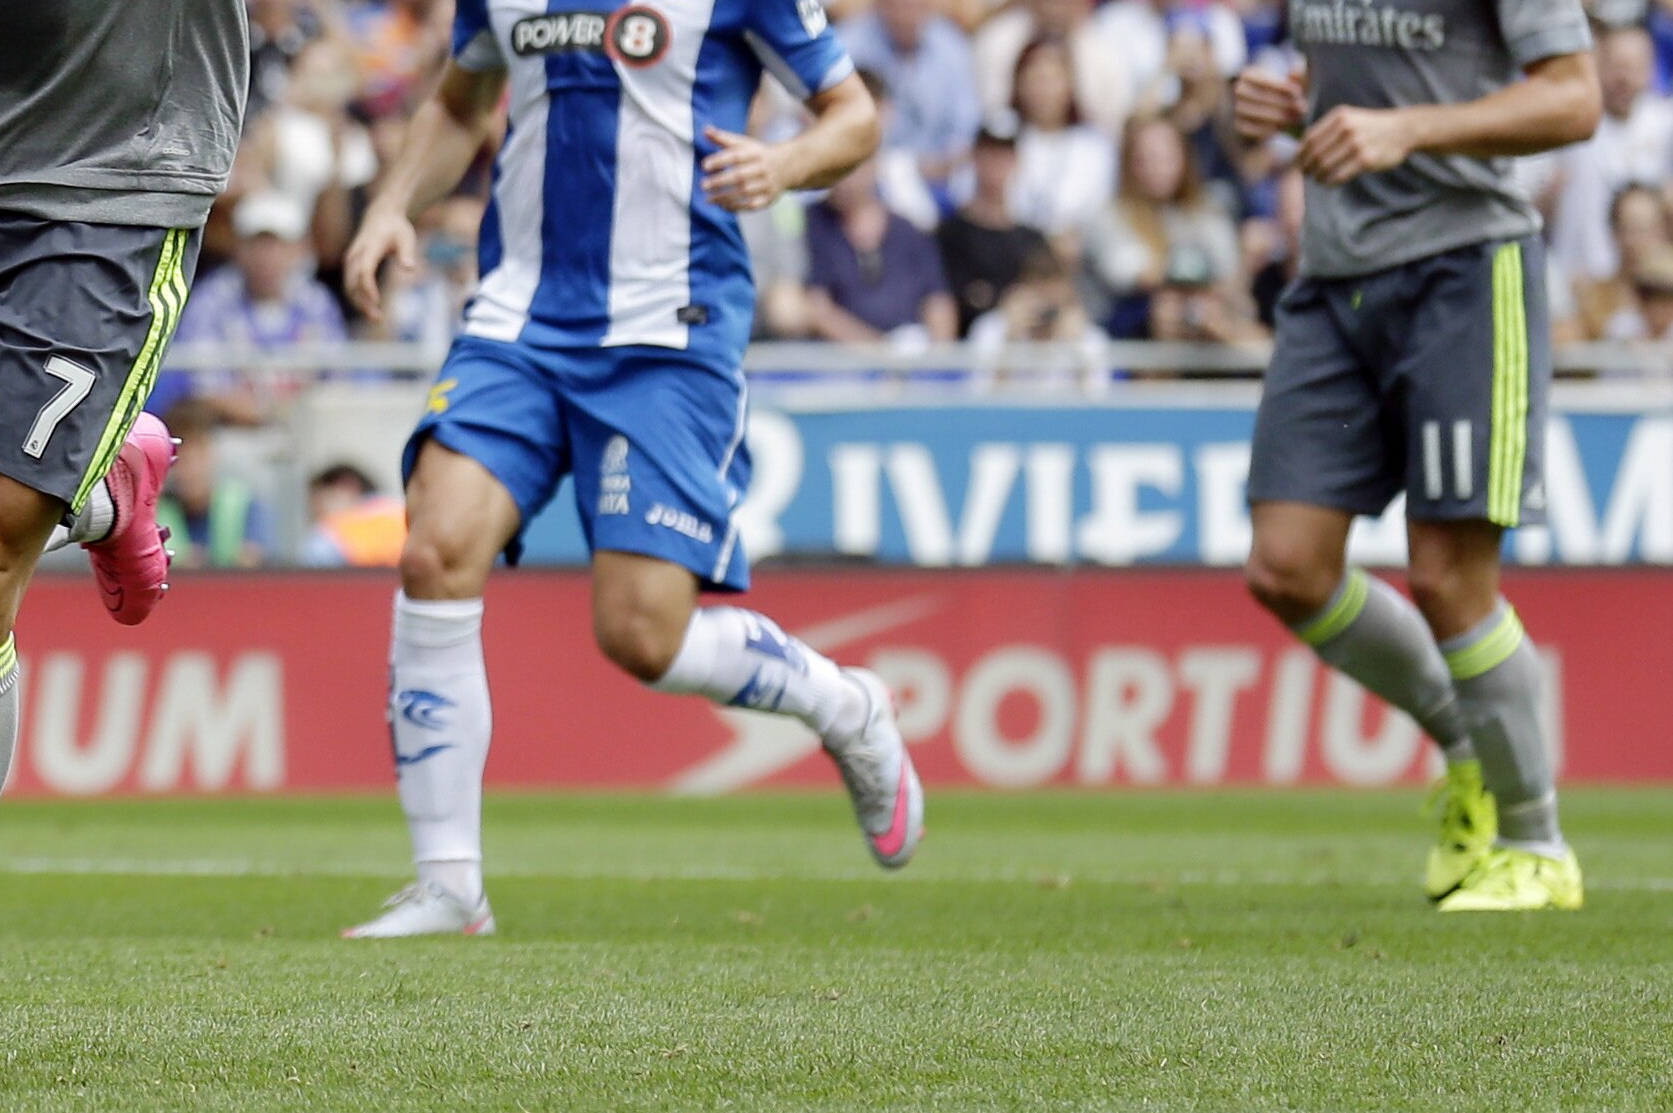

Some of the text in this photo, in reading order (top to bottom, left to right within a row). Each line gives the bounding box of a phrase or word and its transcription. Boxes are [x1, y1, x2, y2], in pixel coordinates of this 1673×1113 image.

[514, 13, 658, 58] POWER 8
[22, 354, 96, 460] 7
[1423, 418, 1473, 501] 11
[644, 502, 714, 544] Joma
[669, 644, 1565, 797] SPORTIU
